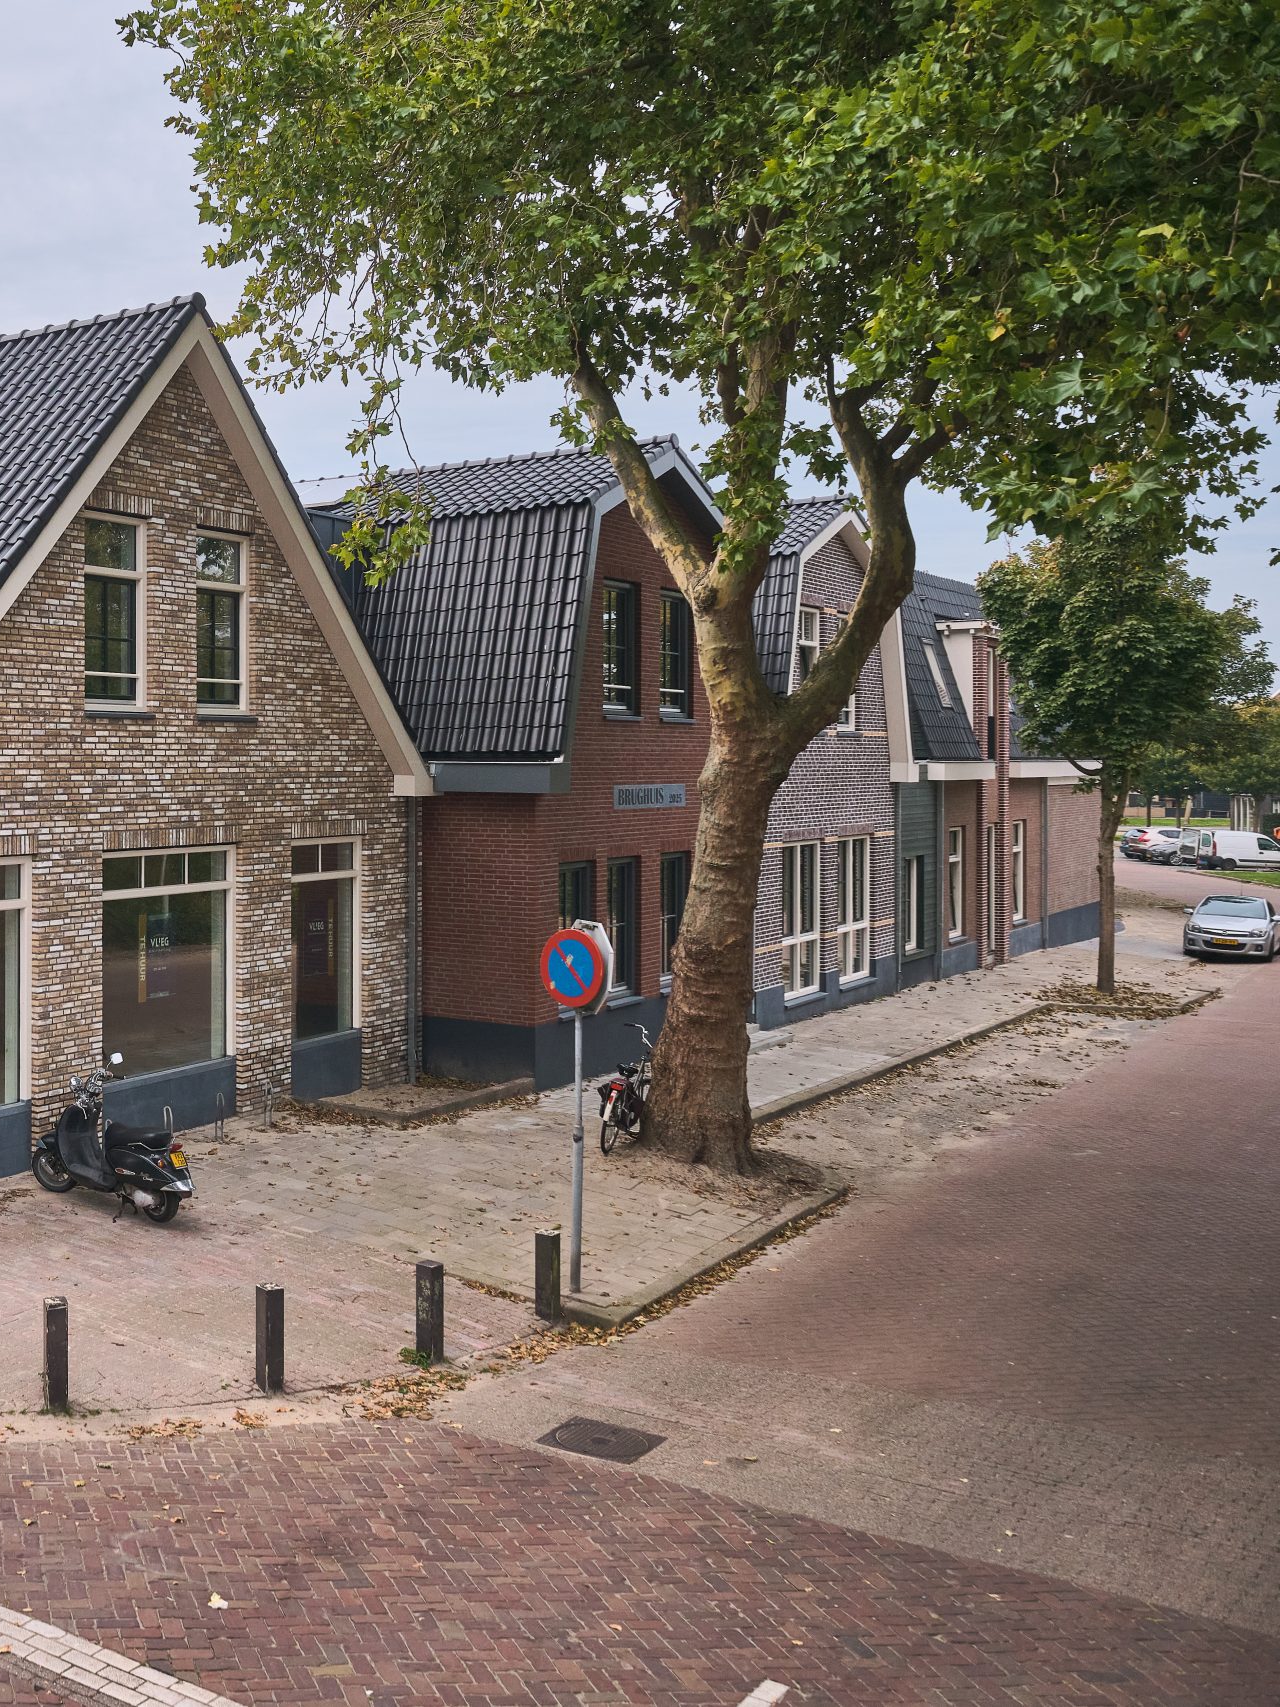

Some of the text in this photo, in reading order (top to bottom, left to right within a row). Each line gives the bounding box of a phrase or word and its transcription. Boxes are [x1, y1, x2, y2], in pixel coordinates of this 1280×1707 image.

[618, 787, 664, 806] BRUGHUIS
[139, 935, 146, 949] TE
[150, 936, 169, 948] VLIEG
